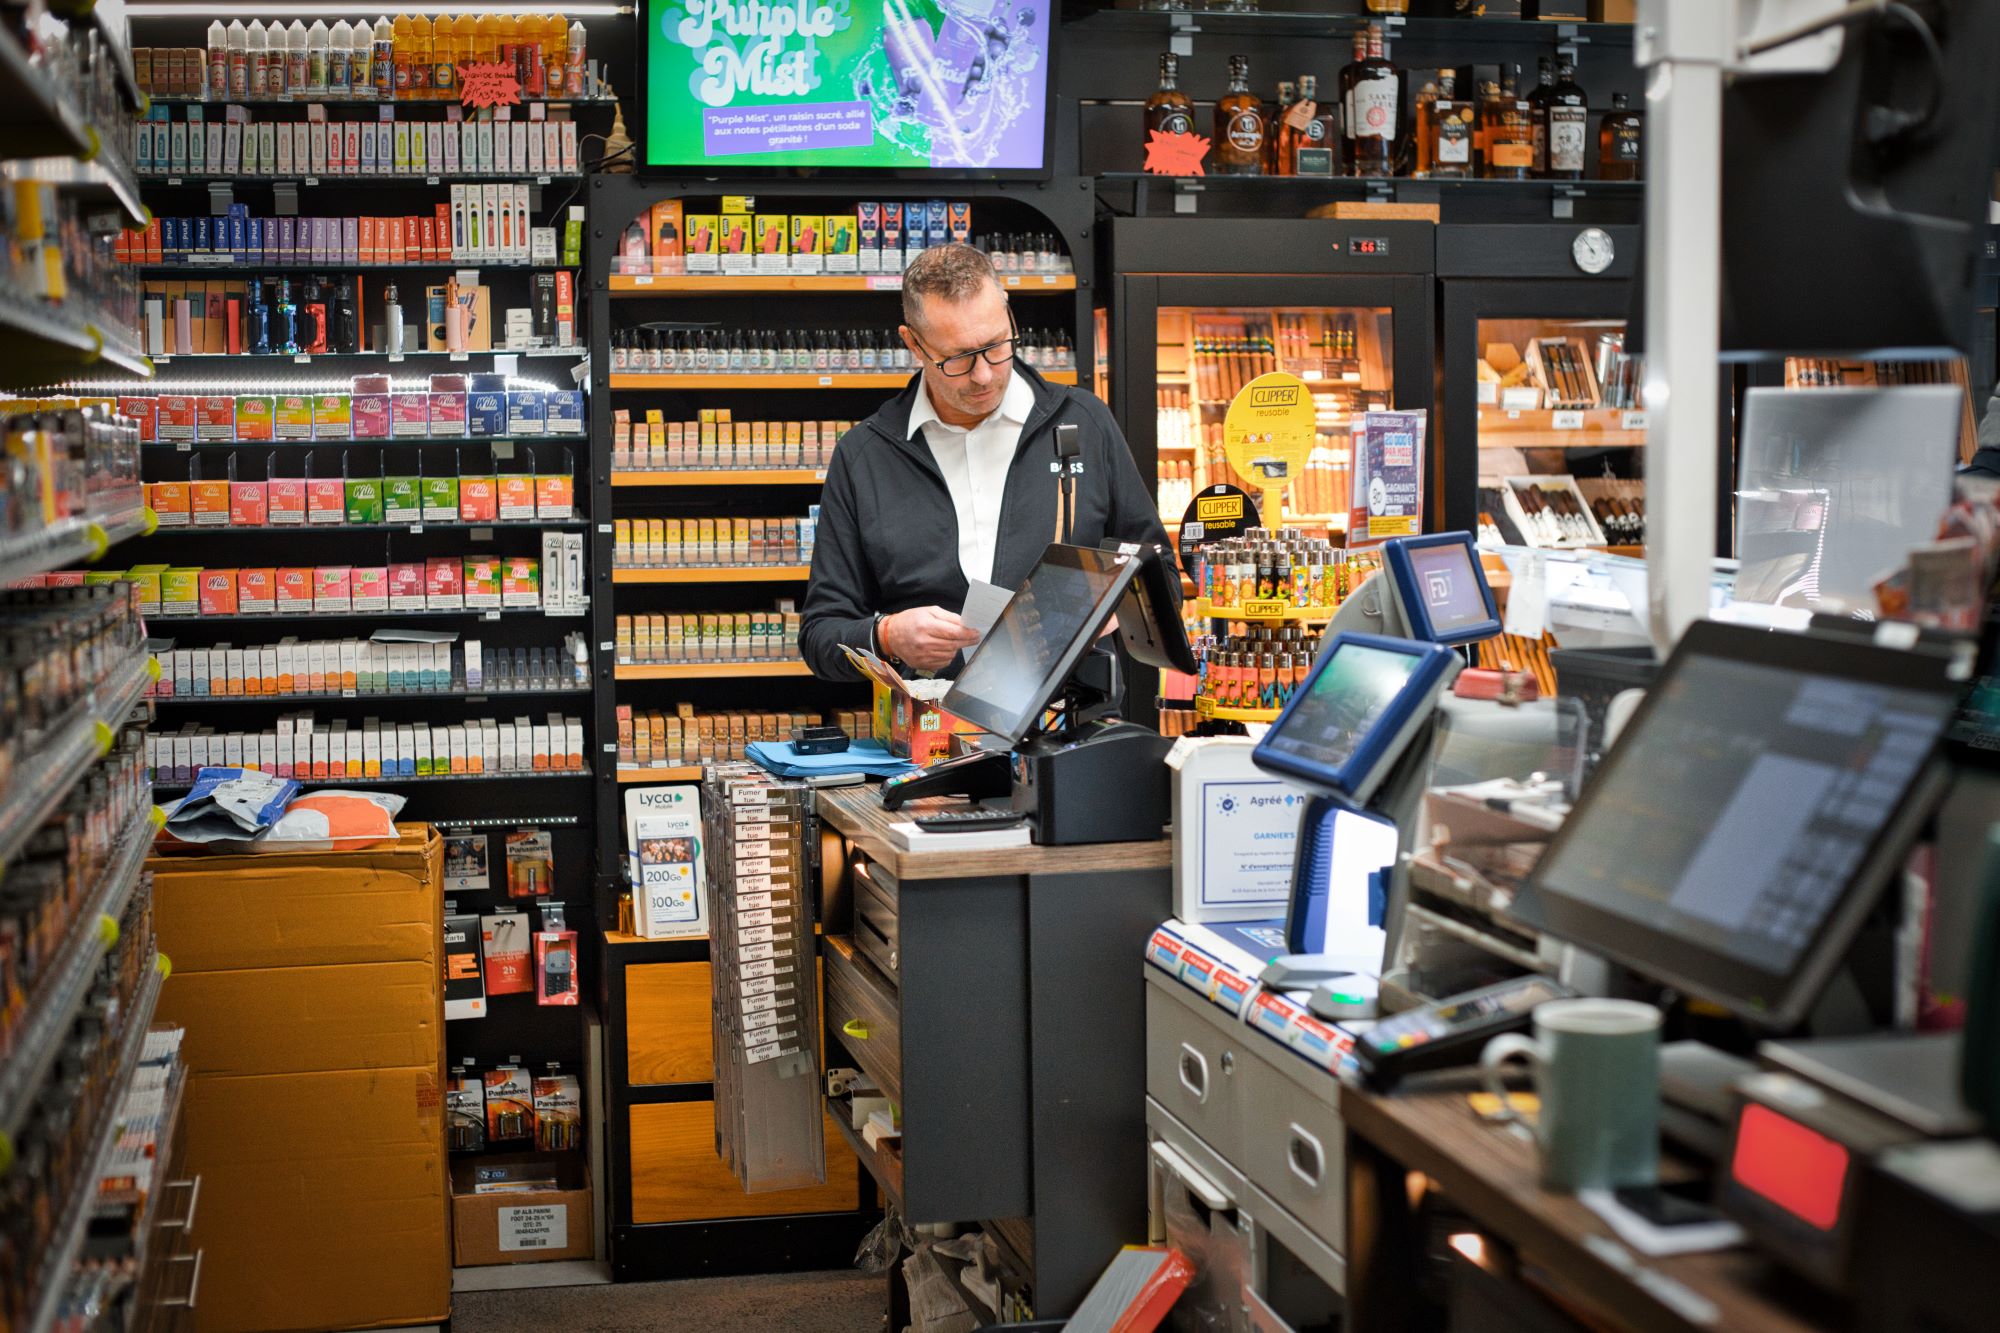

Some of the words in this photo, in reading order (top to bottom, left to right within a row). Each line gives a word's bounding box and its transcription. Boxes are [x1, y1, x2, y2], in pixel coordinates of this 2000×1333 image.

[678, 0, 835, 56] Purple
[700, 42, 810, 106] Mist
[788, 111, 814, 121] raisin
[846, 109, 866, 119] allié
[714, 127, 732, 136] aux
[734, 125, 760, 135] notes
[763, 122, 812, 135] pétillantes
[814, 122, 836, 132] d'un
[837, 121, 860, 131] soda
[768, 134, 802, 146] granité
[400, 395, 418, 405] Wilo
[438, 394, 456, 404] Wilo
[517, 393, 535, 403] Wilo
[555, 392, 573, 402] Wilo
[1255, 389, 1295, 403] CLIPPER
[126, 400, 148, 414] Wilo
[168, 398, 185, 408] Wilo
[206, 399, 223, 408] Wilo
[244, 400, 264, 412] Wilo
[285, 397, 303, 407] Wilo
[322, 397, 340, 407] Wilo
[360, 397, 381, 410] Wilo
[475, 396, 497, 409] Wilo
[1256, 408, 1290, 417] reusable
[1050, 462, 1084, 473] BSS
[393, 481, 410, 491] Wilo
[431, 480, 449, 490] Wilo
[508, 479, 525, 489] Wilo
[1386, 483, 1416, 493] GAGNANTS
[353, 484, 374, 497] Wilo
[468, 483, 489, 496] Wilo
[1395, 494, 1415, 504] FRANCE
[1203, 501, 1238, 515] CLIPPER
[1205, 520, 1236, 530] reusable
[248, 573, 265, 584] Wilo
[285, 573, 303, 584] Wilo
[398, 568, 416, 580] Wilo
[208, 576, 228, 589] Wilo
[1248, 605, 1281, 614] CLIPPER
[639, 793, 673, 807] Lyca
[1250, 796, 1282, 807] Agréé
[667, 820, 685, 829] Lyca
[1254, 832, 1295, 840] GARNIER'S
[509, 845, 550, 854] Panasonic
[745, 945, 766, 953] Fumer
[503, 965, 517, 975] 2h
[745, 961, 767, 970] Fumer
[746, 978, 768, 987] Fumer
[747, 995, 769, 1004] Fumer
[748, 1011, 770, 1020] Fumer
[749, 1028, 771, 1038] Fumer
[751, 1045, 773, 1054] Fumer
[488, 1087, 529, 1097] Panasonic
[537, 1099, 577, 1108] Panasonic
